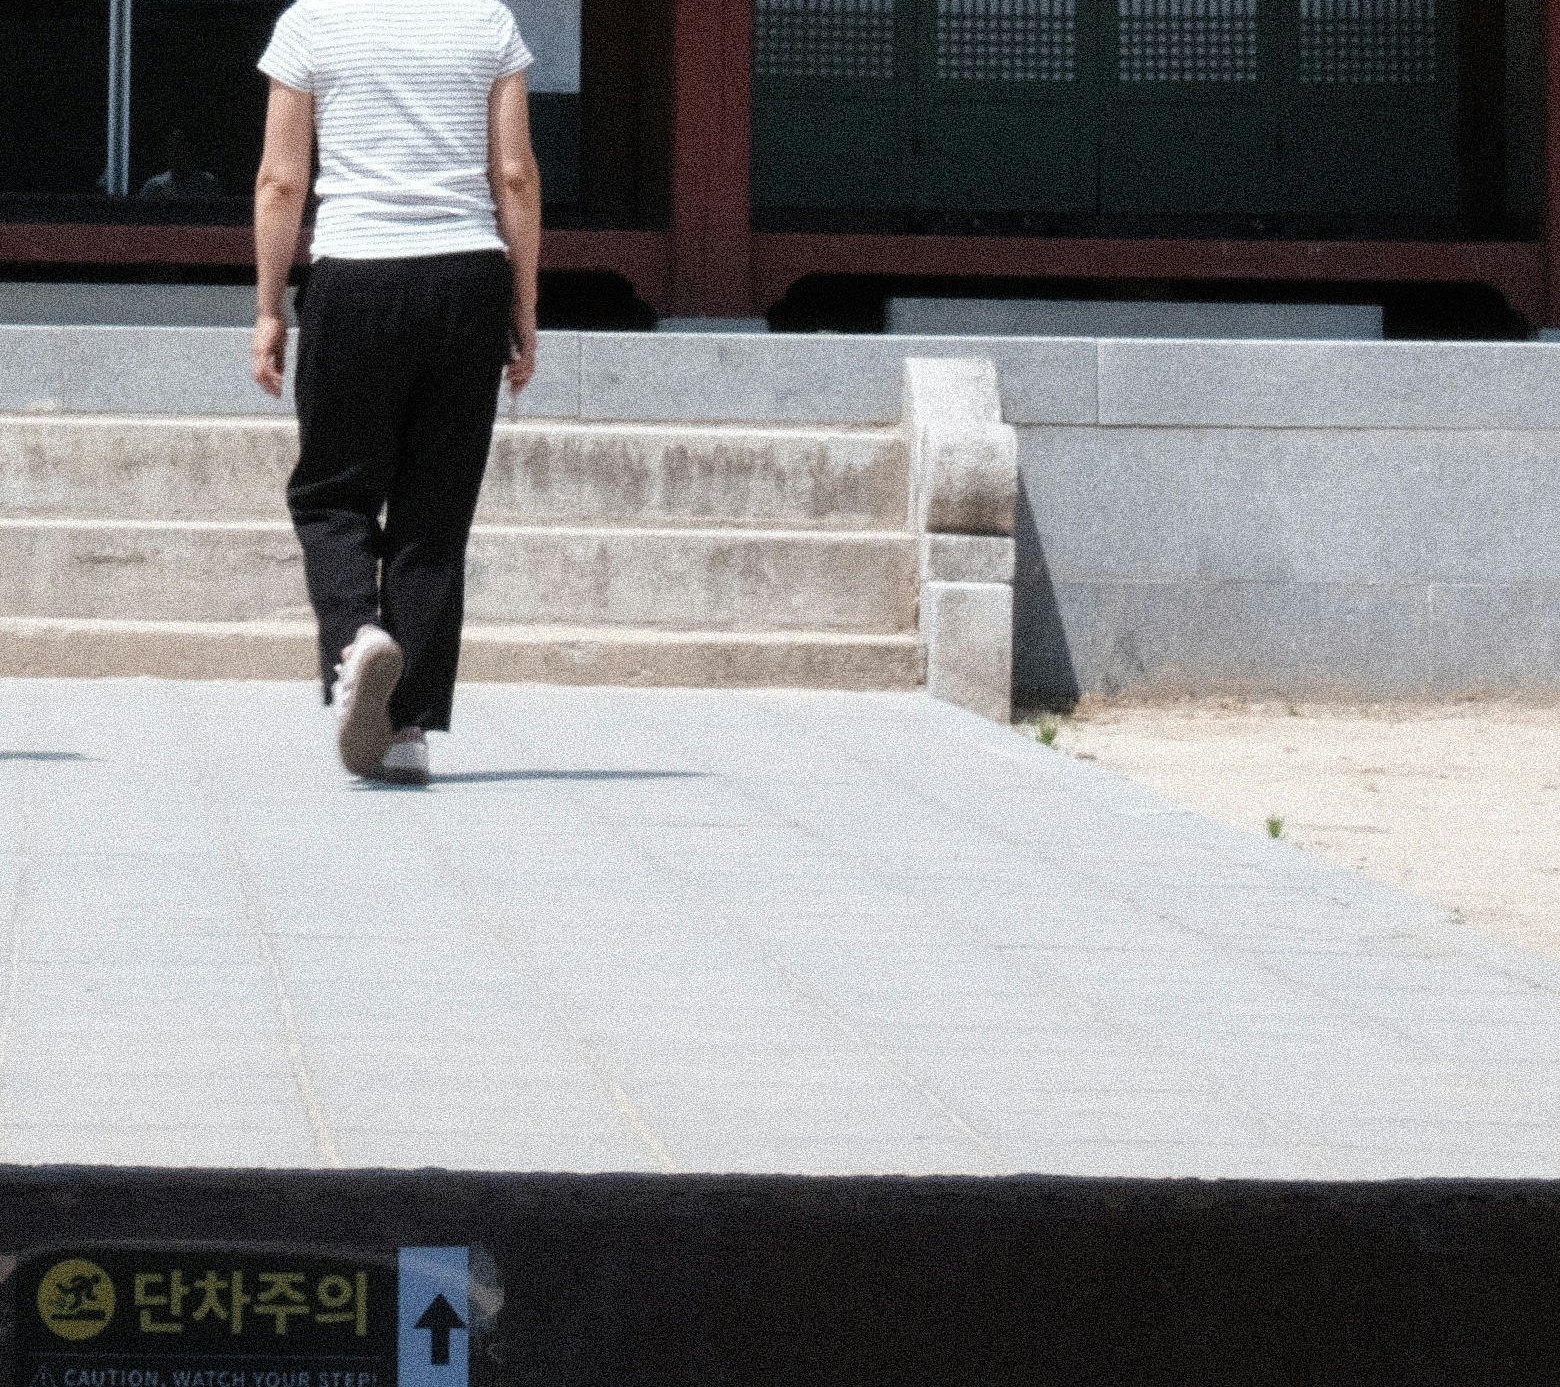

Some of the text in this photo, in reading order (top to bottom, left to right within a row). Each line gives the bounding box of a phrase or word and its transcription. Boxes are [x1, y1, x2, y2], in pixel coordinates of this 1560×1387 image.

[133, 1270, 369, 1336] 단차주의
[172, 1369, 246, 1387] WATCH
[252, 1370, 312, 1387] YOUR
